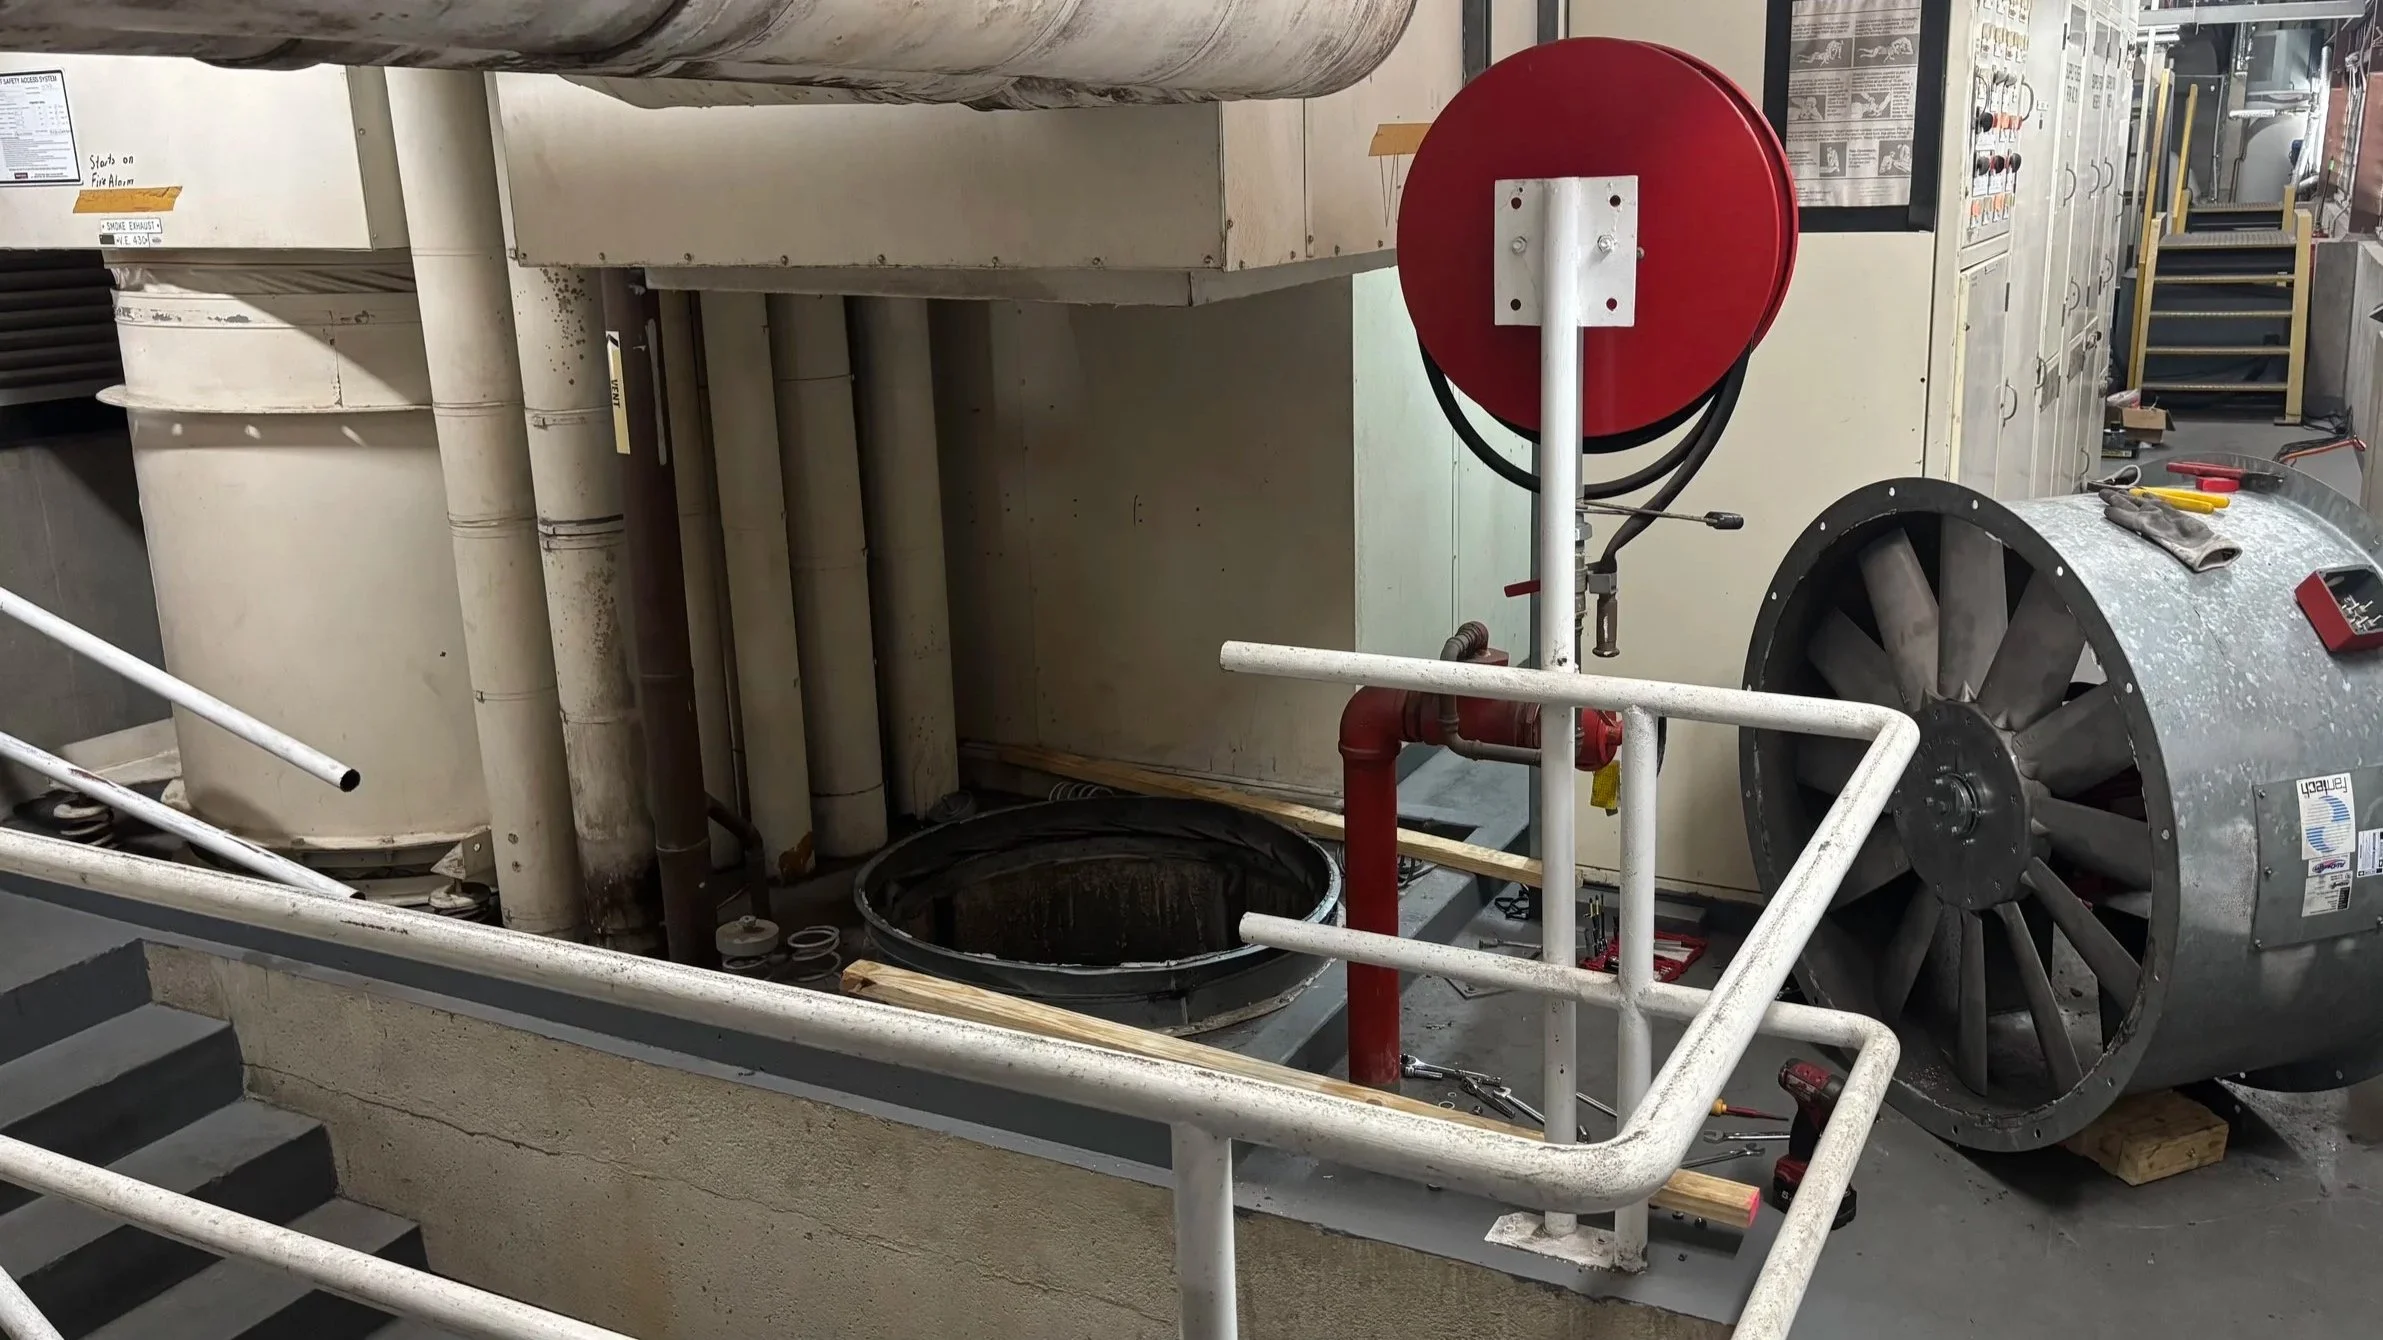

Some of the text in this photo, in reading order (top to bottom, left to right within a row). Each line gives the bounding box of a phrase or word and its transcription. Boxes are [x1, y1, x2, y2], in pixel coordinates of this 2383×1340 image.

[3, 77, 20, 85] SAFETY
[20, 76, 39, 84] ACCESS
[39, 75, 57, 83] SYSTEM
[89, 153, 134, 170] Starts on
[91, 172, 107, 188] Fire
[106, 220, 155, 231] SMOKE EXHAUST
[610, 379, 621, 409] VENT
[2300, 776, 2348, 799] fantech
